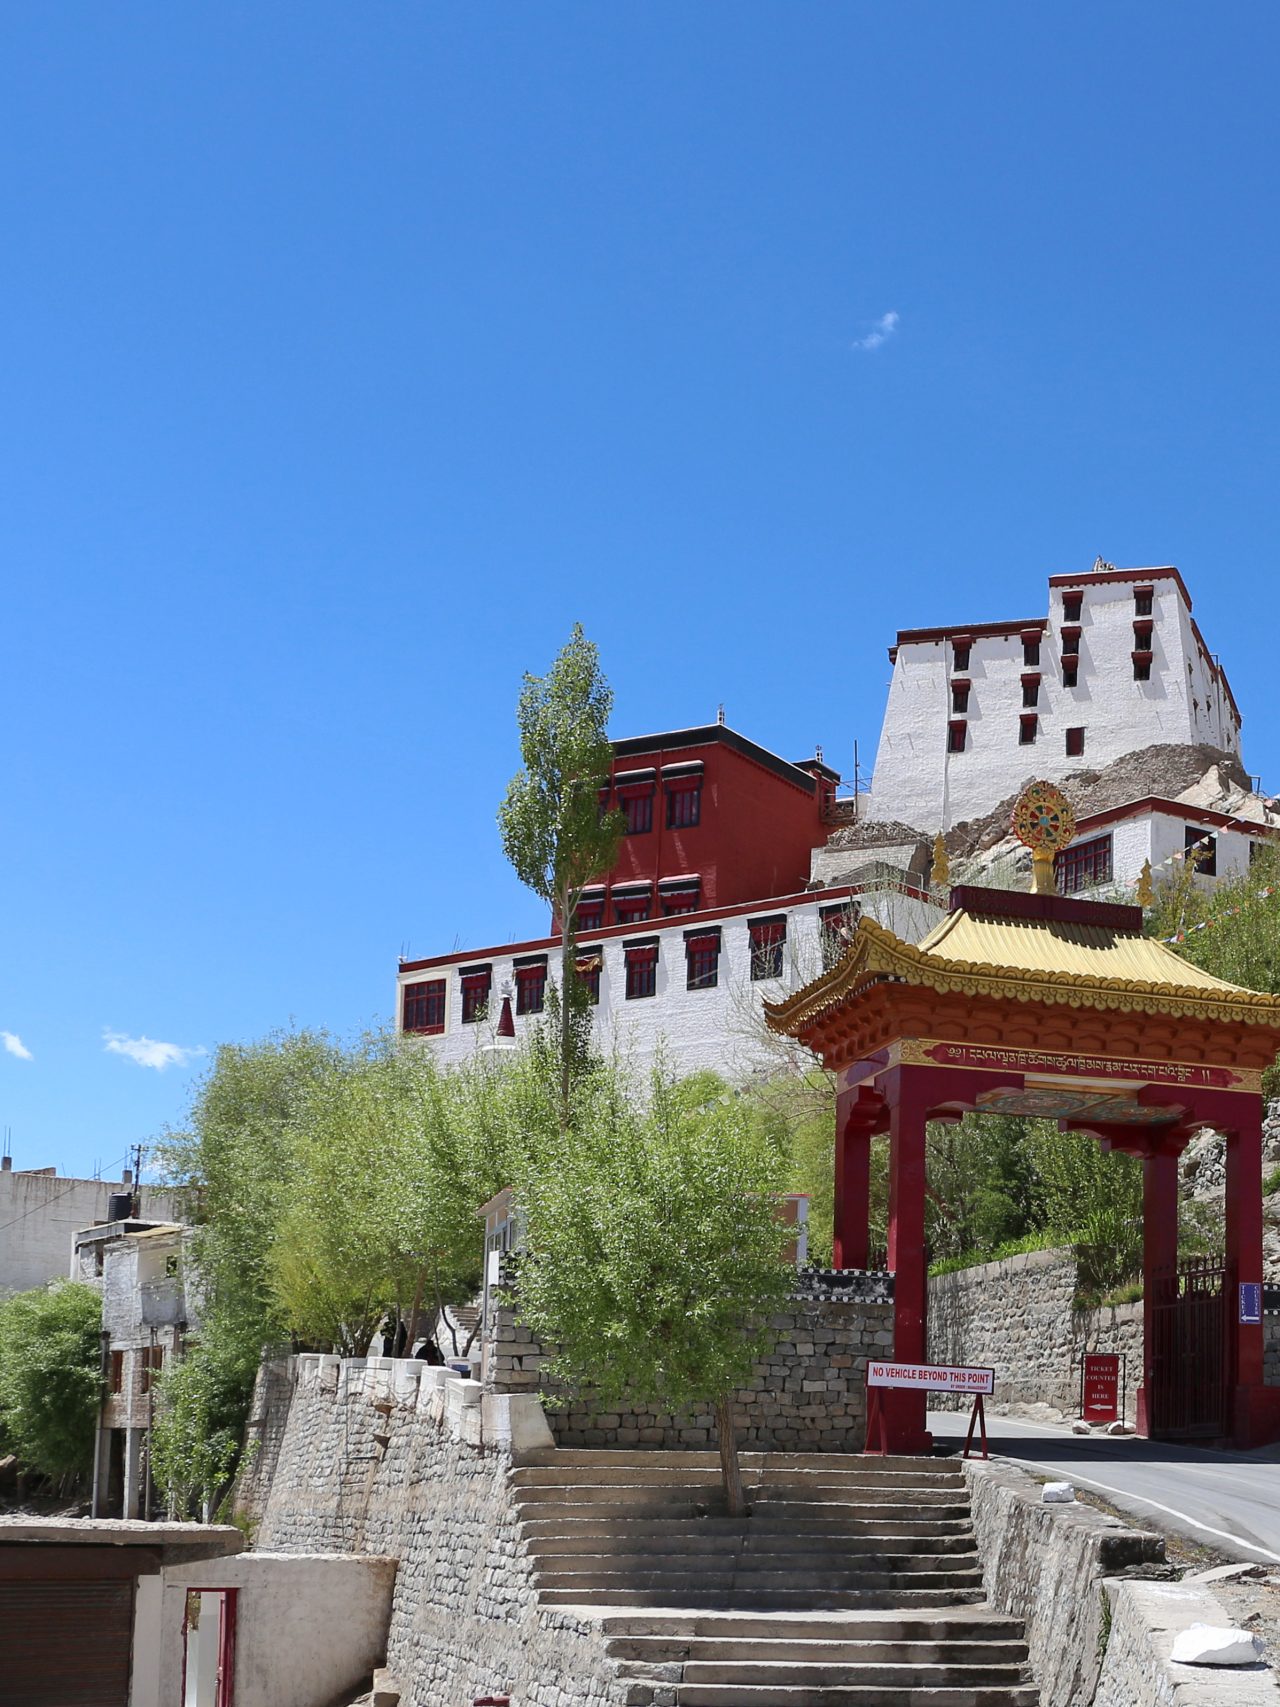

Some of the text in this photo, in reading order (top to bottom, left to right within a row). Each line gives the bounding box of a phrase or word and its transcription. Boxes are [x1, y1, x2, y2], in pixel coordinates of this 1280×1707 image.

[872, 1367, 989, 1384] NO VEHICLE BEYOND THIS POINT
